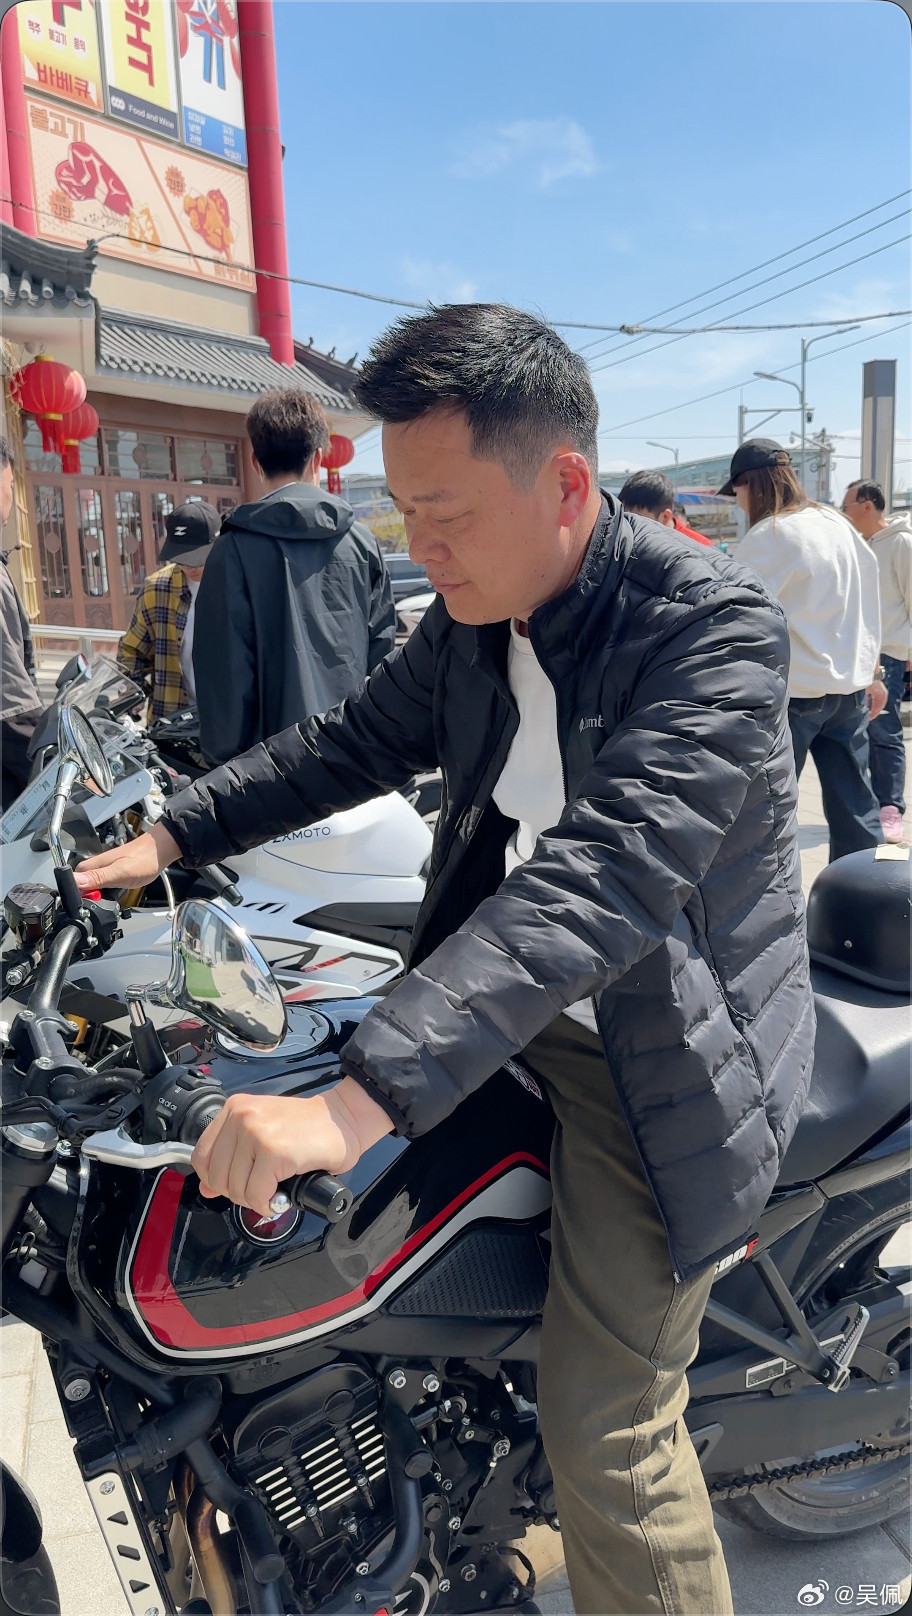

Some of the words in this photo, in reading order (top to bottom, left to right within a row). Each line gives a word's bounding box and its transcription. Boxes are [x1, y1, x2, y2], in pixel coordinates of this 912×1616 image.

[48, 28, 67, 46] 불고기
[36, 61, 91, 99] 바베큐
[30, 105, 86, 142] 불고기
[128, 104, 145, 118] Food
[146, 112, 159, 123] and
[159, 117, 175, 130] Wine
